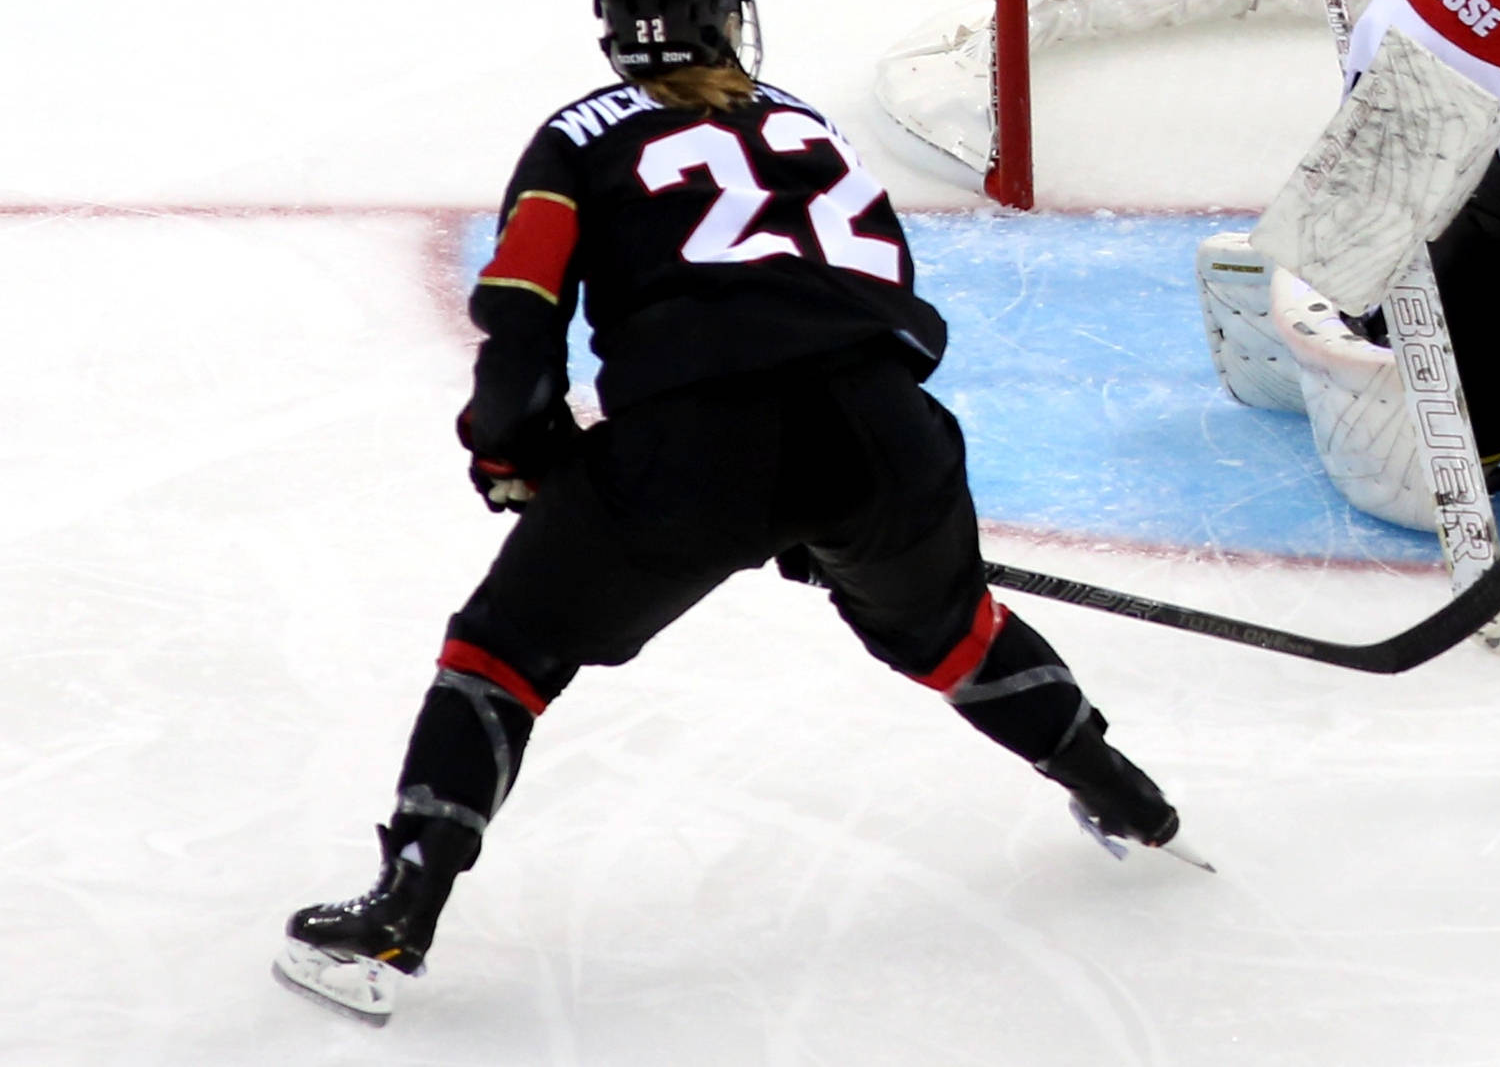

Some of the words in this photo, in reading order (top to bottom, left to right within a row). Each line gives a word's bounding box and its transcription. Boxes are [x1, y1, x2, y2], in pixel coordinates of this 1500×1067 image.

[635, 17, 667, 44] 22
[634, 110, 900, 285] 22
[1389, 285, 1494, 564] BAUER
[983, 561, 1162, 621] AUER
